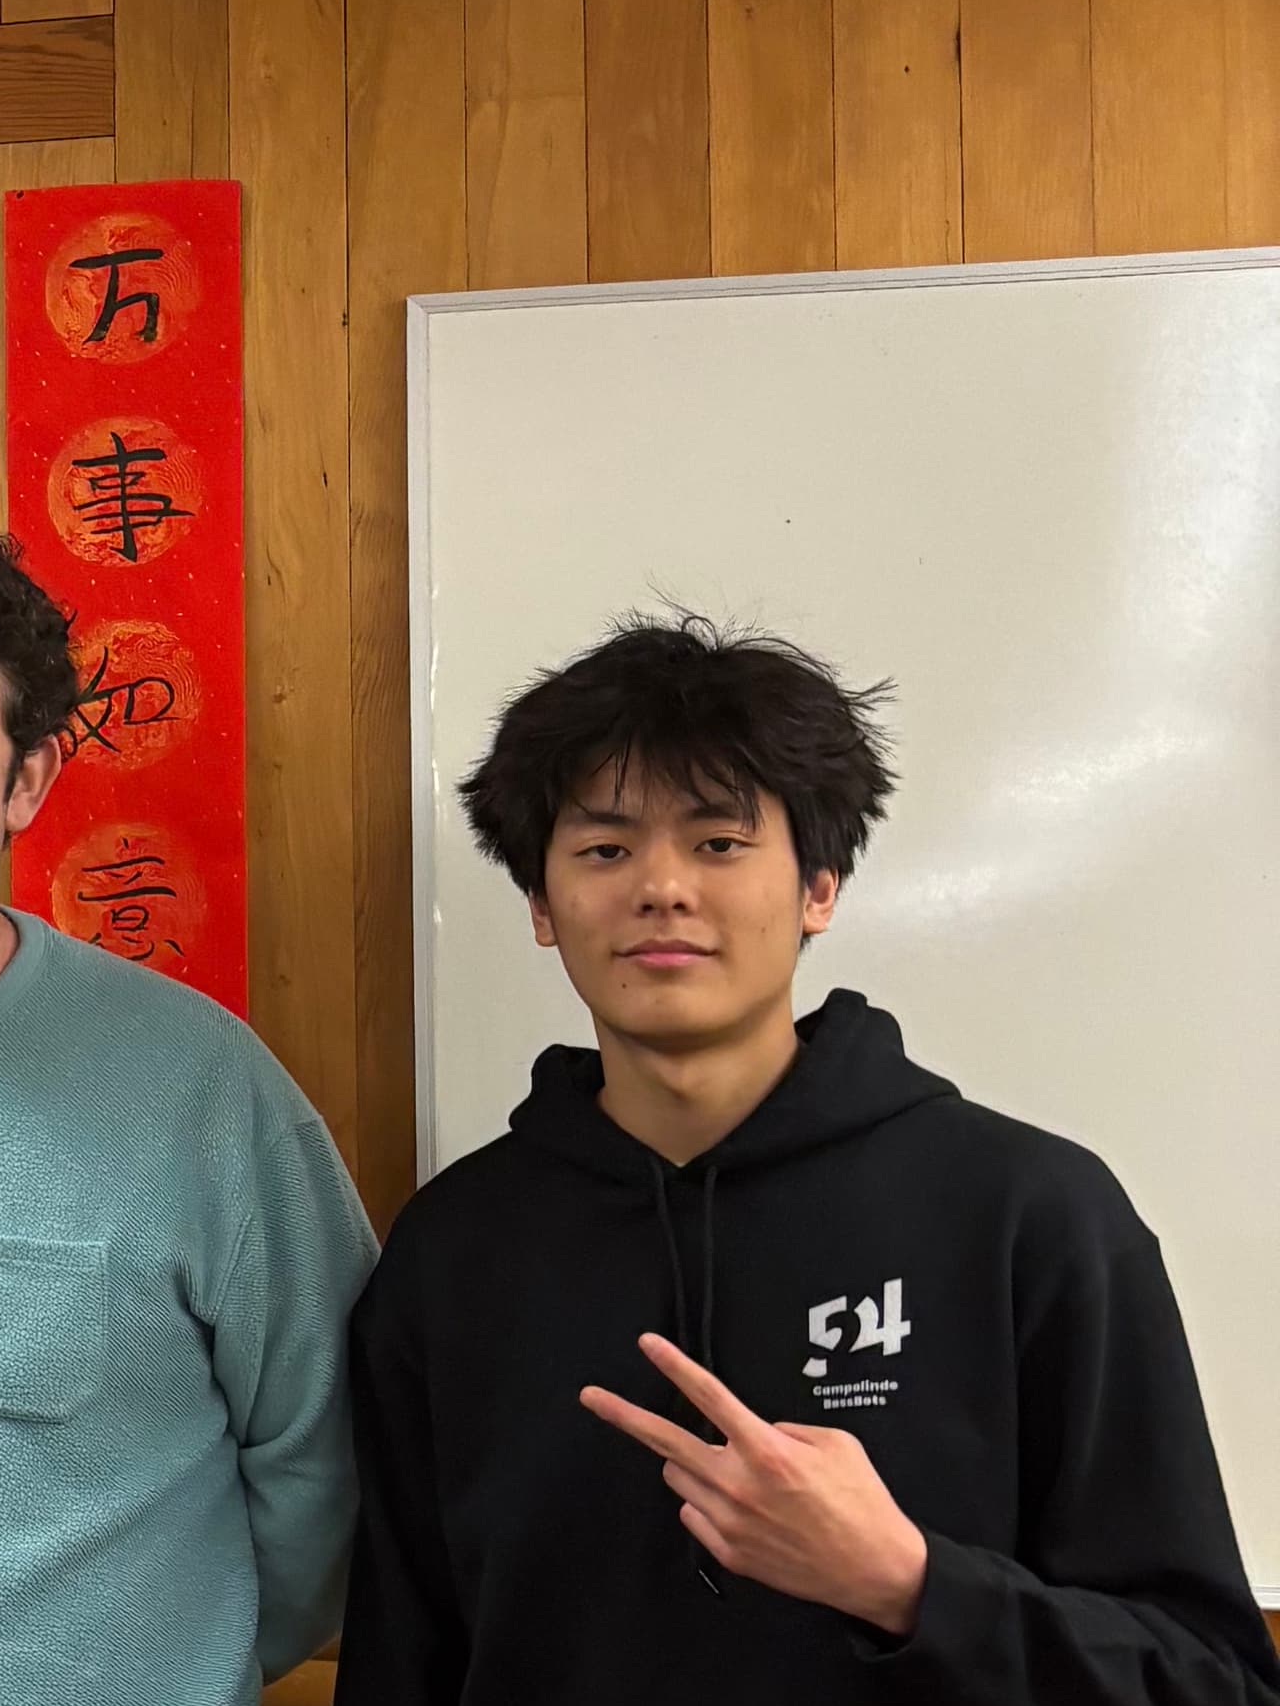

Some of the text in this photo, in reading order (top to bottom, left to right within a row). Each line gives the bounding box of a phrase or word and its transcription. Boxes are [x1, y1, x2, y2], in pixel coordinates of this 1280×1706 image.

[69, 247, 197, 960] 万事如意
[802, 1277, 911, 1378] 54
